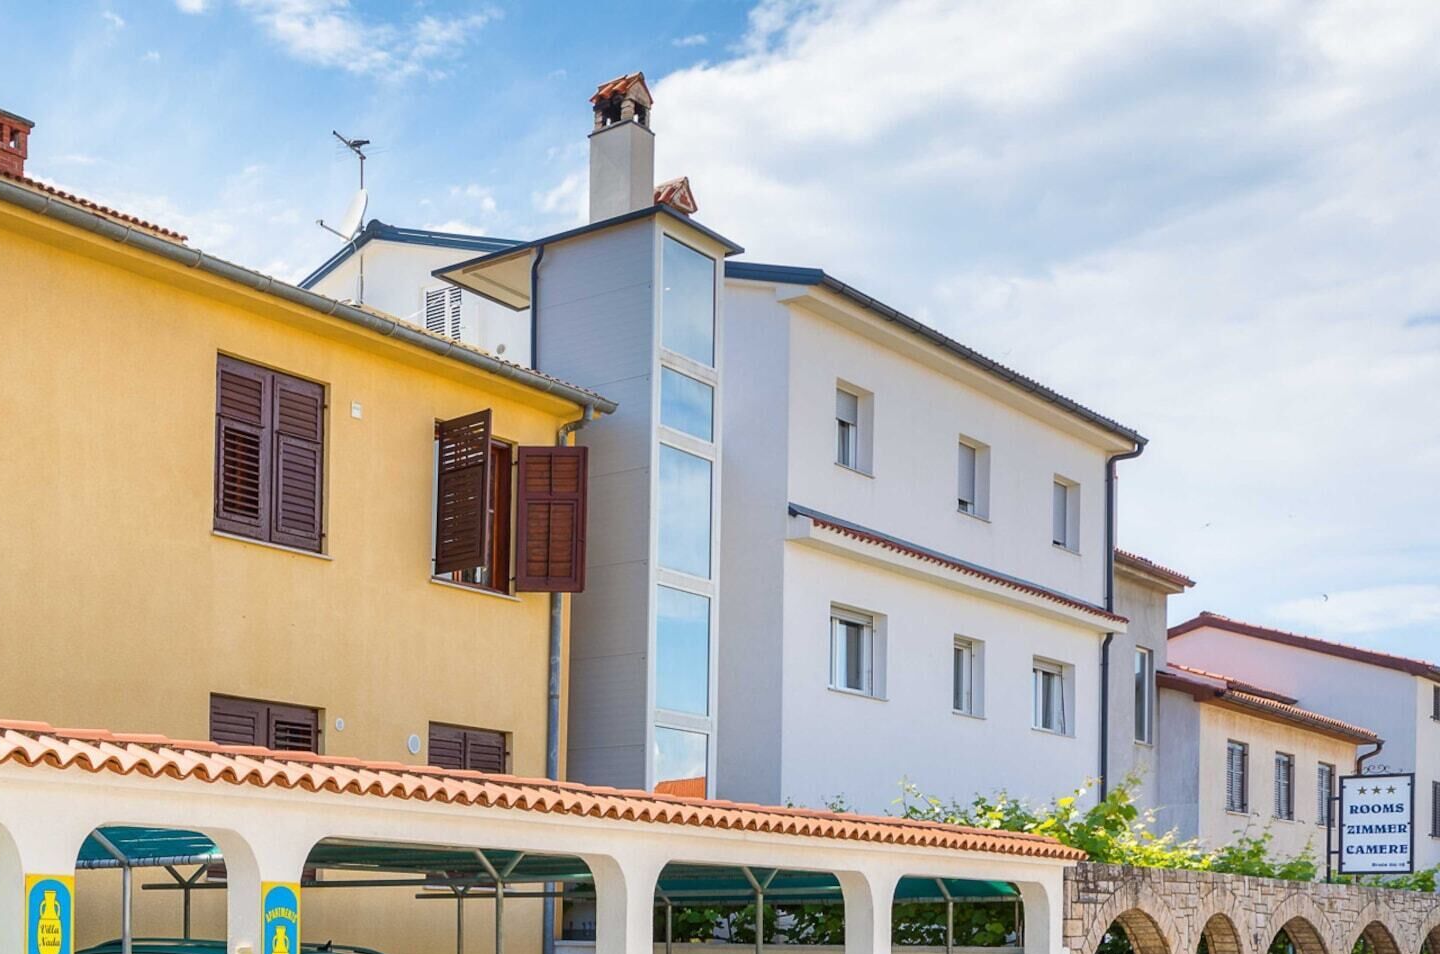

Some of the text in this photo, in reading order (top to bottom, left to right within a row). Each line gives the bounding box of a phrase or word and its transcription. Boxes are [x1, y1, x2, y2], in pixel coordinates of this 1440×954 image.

[1349, 803, 1404, 814] ROOMS
[1347, 824, 1407, 834] ZIMMER
[1346, 844, 1408, 854] CAMERE
[40, 924, 59, 934] Villa
[39, 936, 60, 947] Nada
